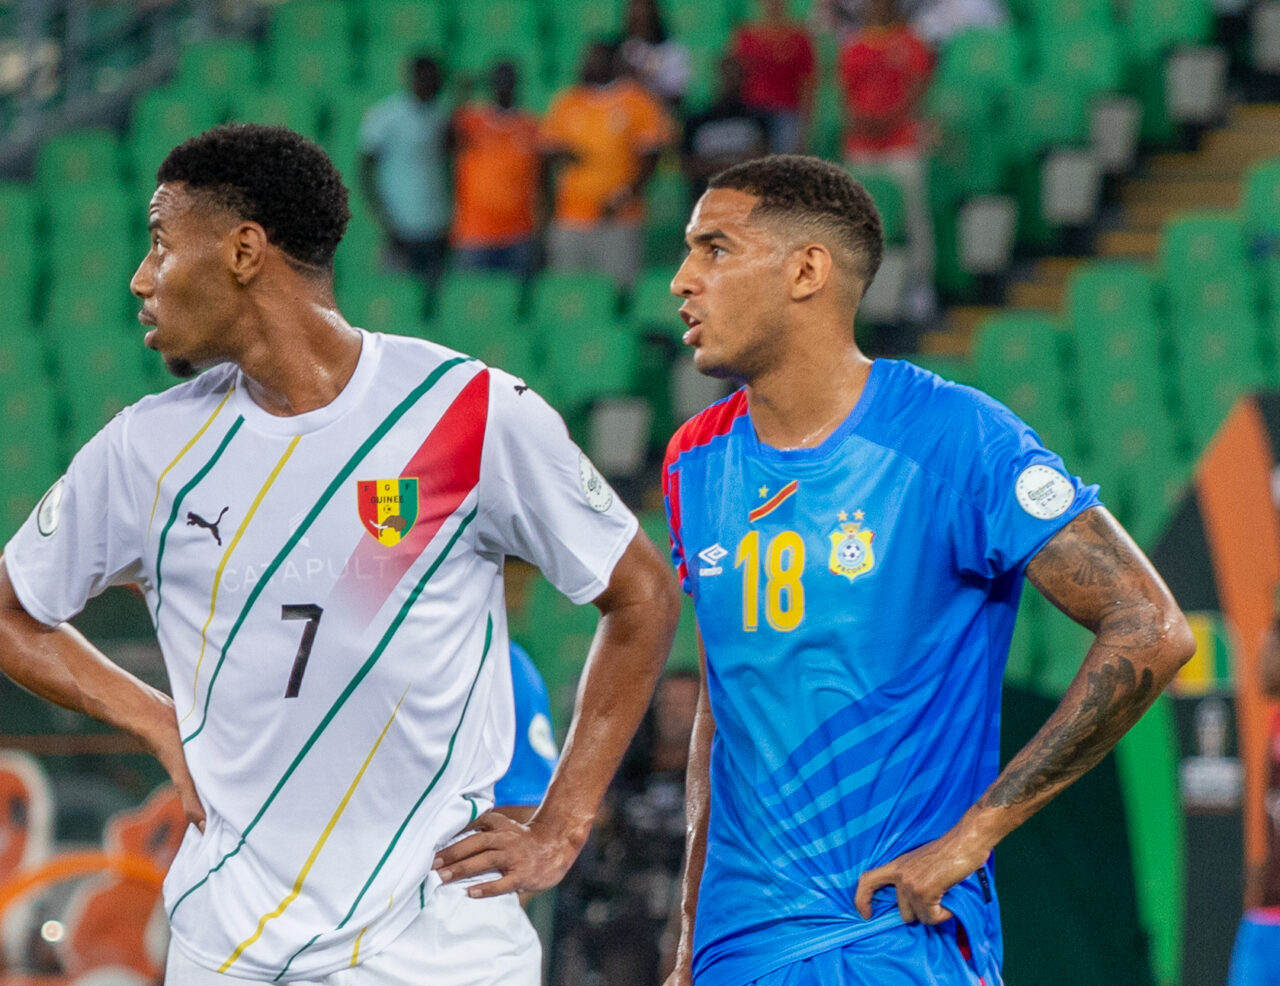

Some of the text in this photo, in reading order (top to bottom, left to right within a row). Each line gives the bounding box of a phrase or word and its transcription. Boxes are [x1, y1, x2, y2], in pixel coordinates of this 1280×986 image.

[222, 556, 391, 593] CATAPULT
[734, 530, 806, 632] 18
[281, 603, 324, 699] 7
